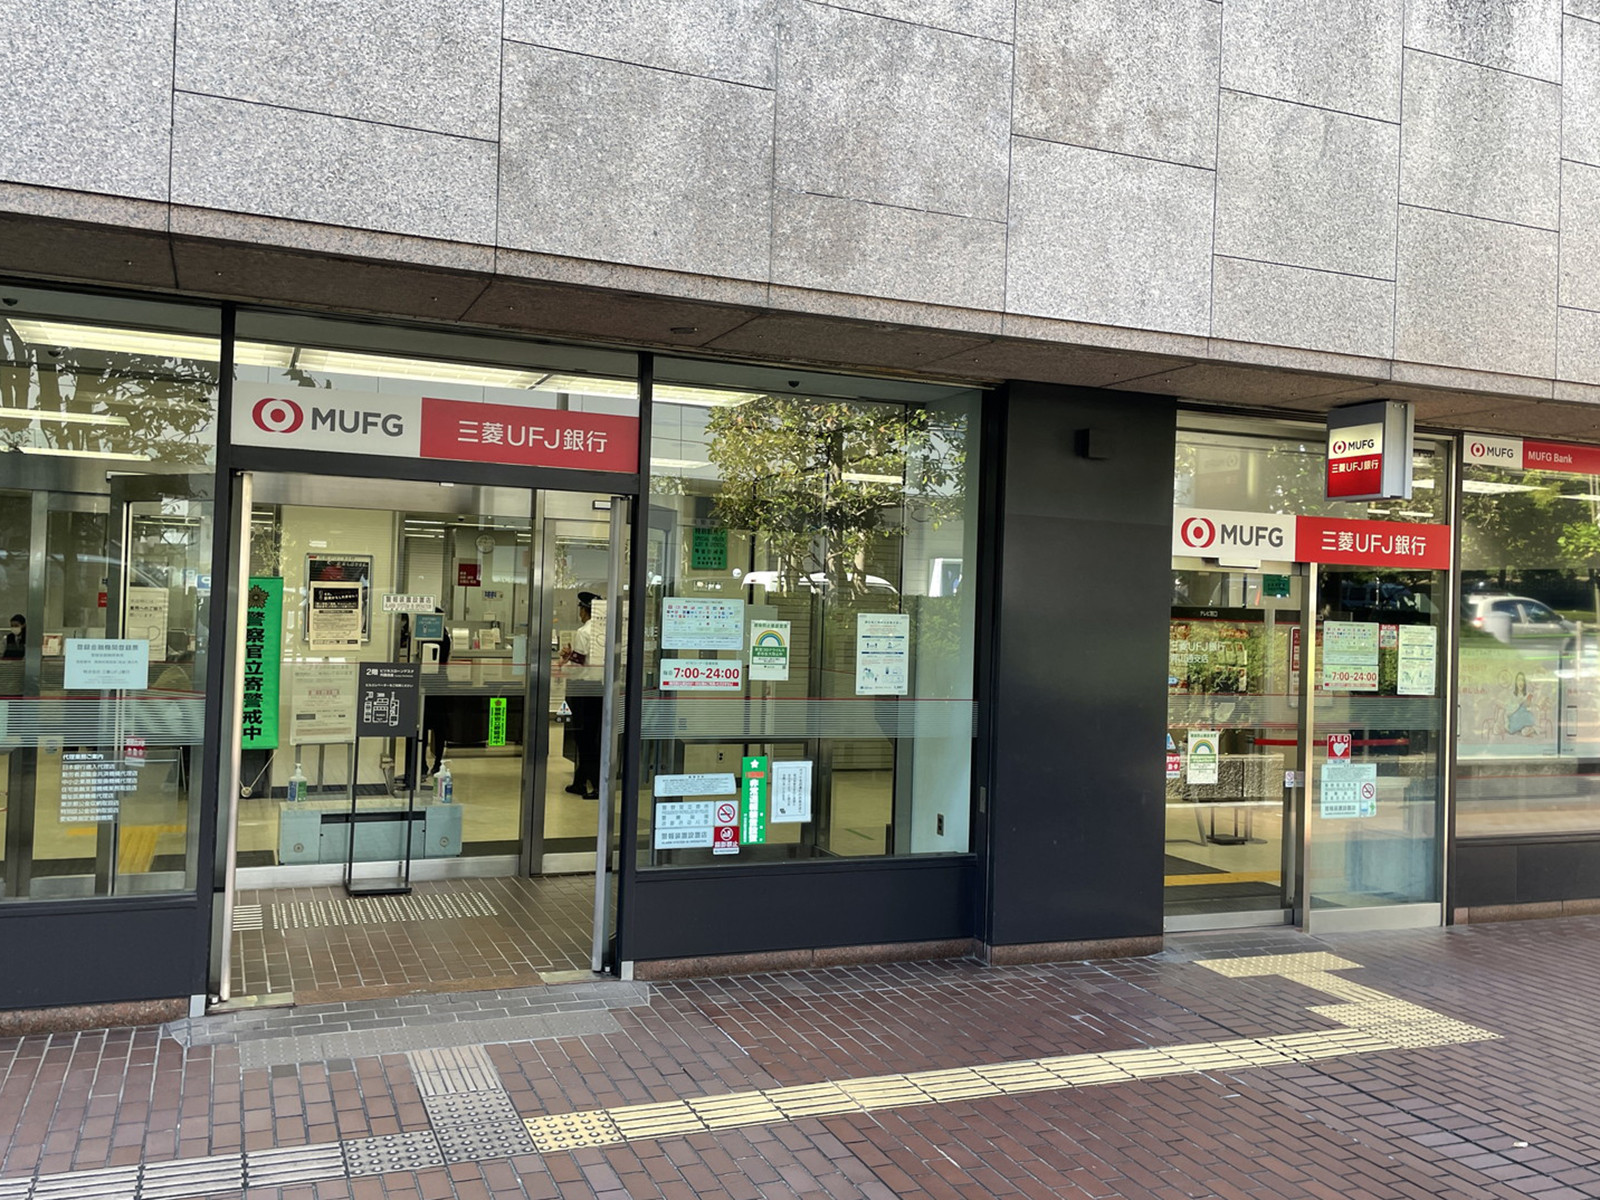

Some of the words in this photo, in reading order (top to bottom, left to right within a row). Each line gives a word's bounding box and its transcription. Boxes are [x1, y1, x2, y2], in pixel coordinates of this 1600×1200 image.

[312, 407, 403, 437] MUFG
[457, 419, 608, 453] 三菱UFJ銀行
[1348, 439, 1375, 450] MUFG
[1487, 446, 1514, 458] MUFG
[1528, 451, 1552, 462] MUFG
[1554, 453, 1573, 464] Bank
[1331, 460, 1379, 474] 三菱UFJ銀行
[1220, 523, 1284, 548] MUFG
[1321, 530, 1427, 556] 三菱UFJ銀行
[242, 611, 265, 741] 警察官立寄警戒中
